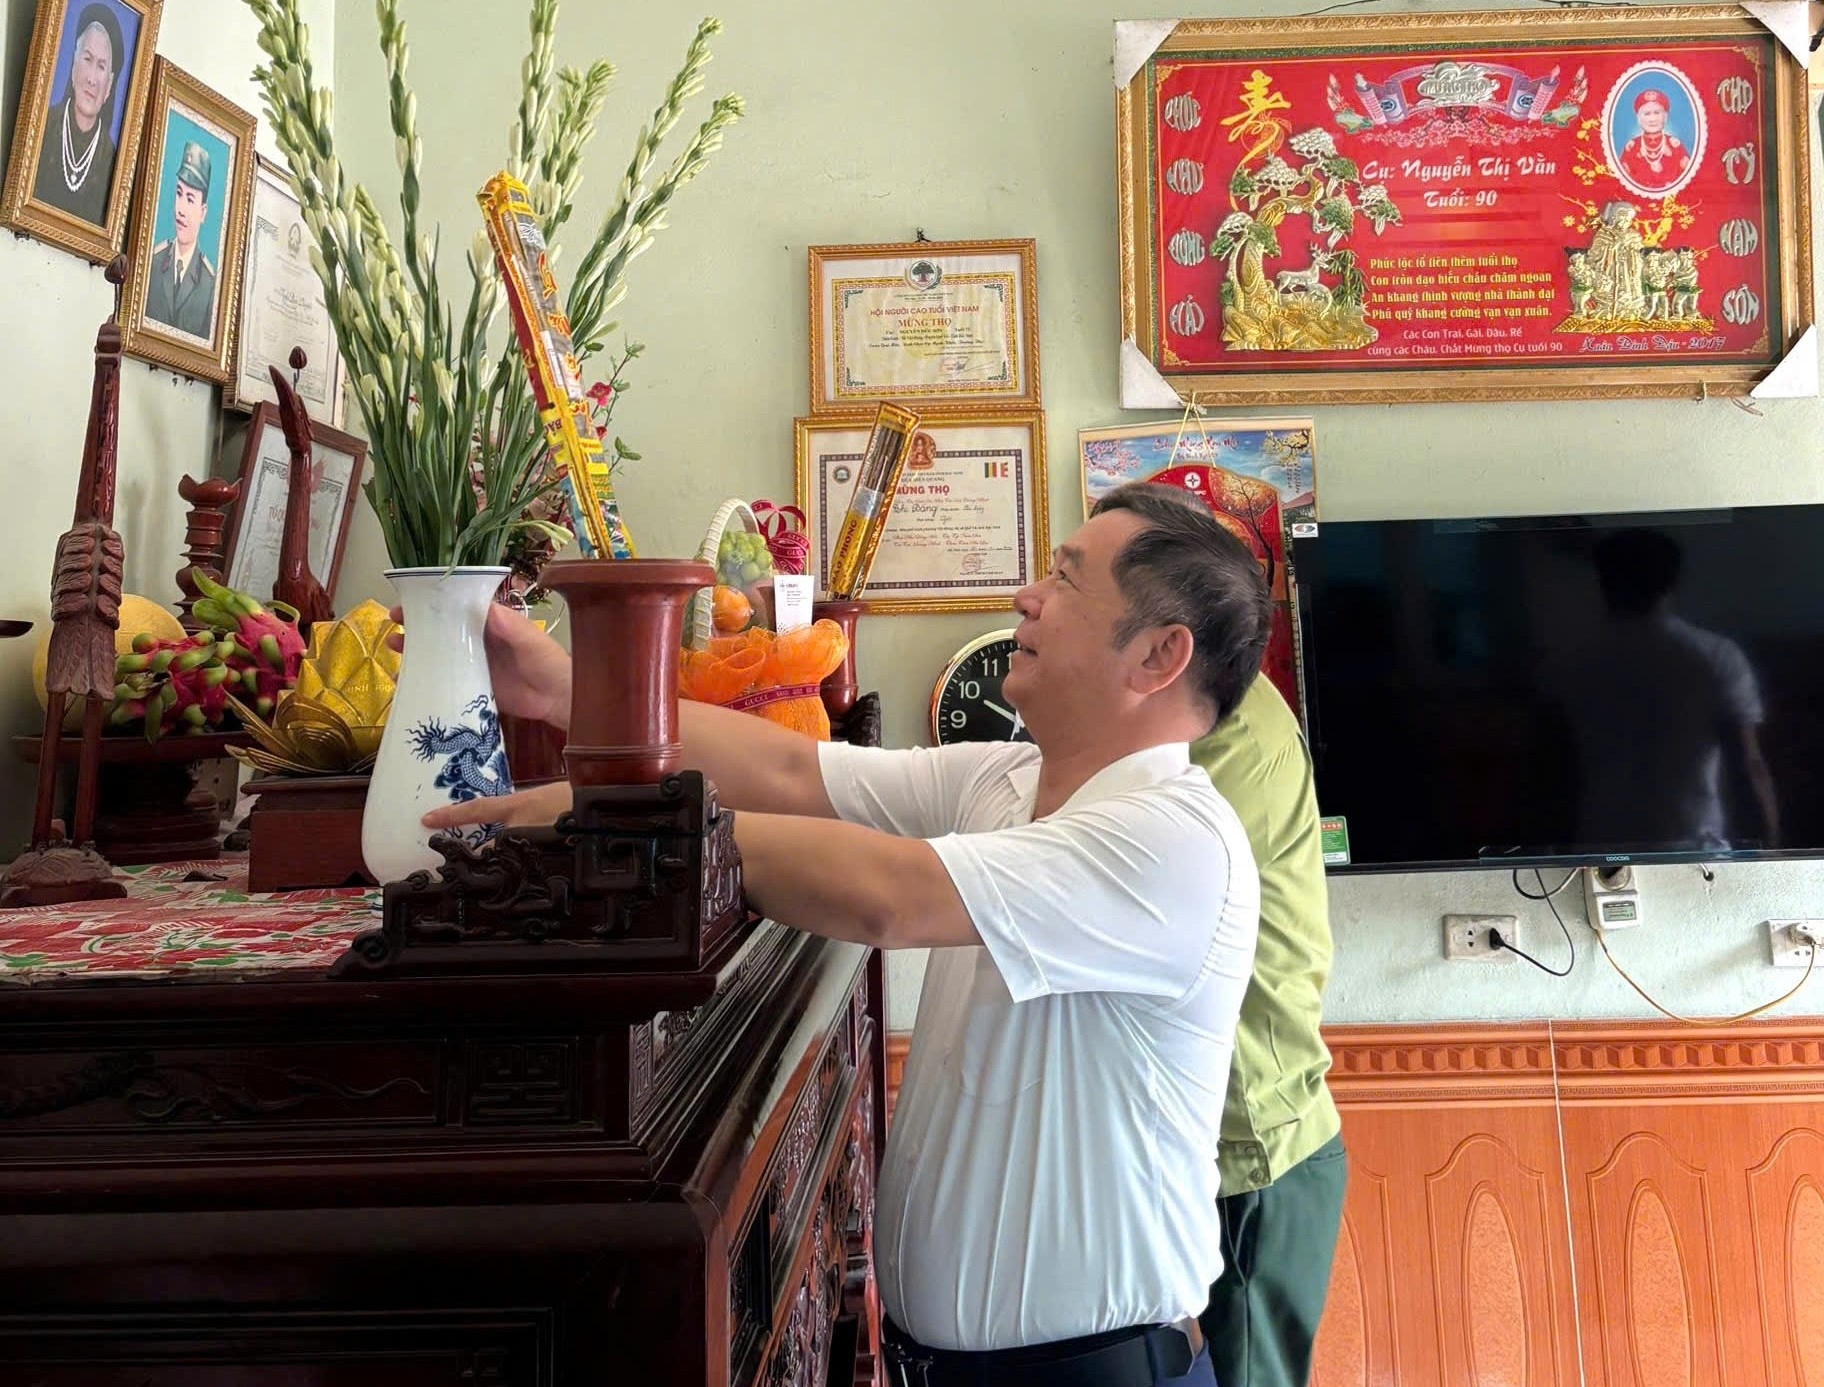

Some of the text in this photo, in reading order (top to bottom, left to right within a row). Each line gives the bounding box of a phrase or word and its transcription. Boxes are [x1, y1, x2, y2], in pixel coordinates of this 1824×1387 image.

[1362, 160, 1396, 184] Cụ:
[1401, 155, 1471, 182] Nguyễn
[1478, 157, 1511, 181] Thị
[1424, 187, 1498, 208] Tuổi: 90
[1719, 218, 1758, 257] NAM
[1370, 257, 1393, 269] Phúc
[1501, 255, 1518, 269] thọ
[1371, 275, 1389, 286] Con
[1520, 272, 1552, 284] ngoan
[1371, 292, 1384, 303] An
[1387, 291, 1418, 303] khang
[910, 306, 928, 315] CAO
[961, 304, 980, 313] NAM
[1415, 307, 1447, 320] khang
[1483, 308, 1501, 320] vạn
[1503, 308, 1521, 319] vạn
[1422, 329, 1440, 339] Con
[1494, 342, 1511, 353] thọ
[1550, 341, 1563, 352] 90
[1688, 336, 1727, 351] 2017
[928, 485, 950, 496] THỌ
[982, 658, 999, 677] 11
[958, 680, 980, 699] 10
[950, 709, 967, 729] 9
